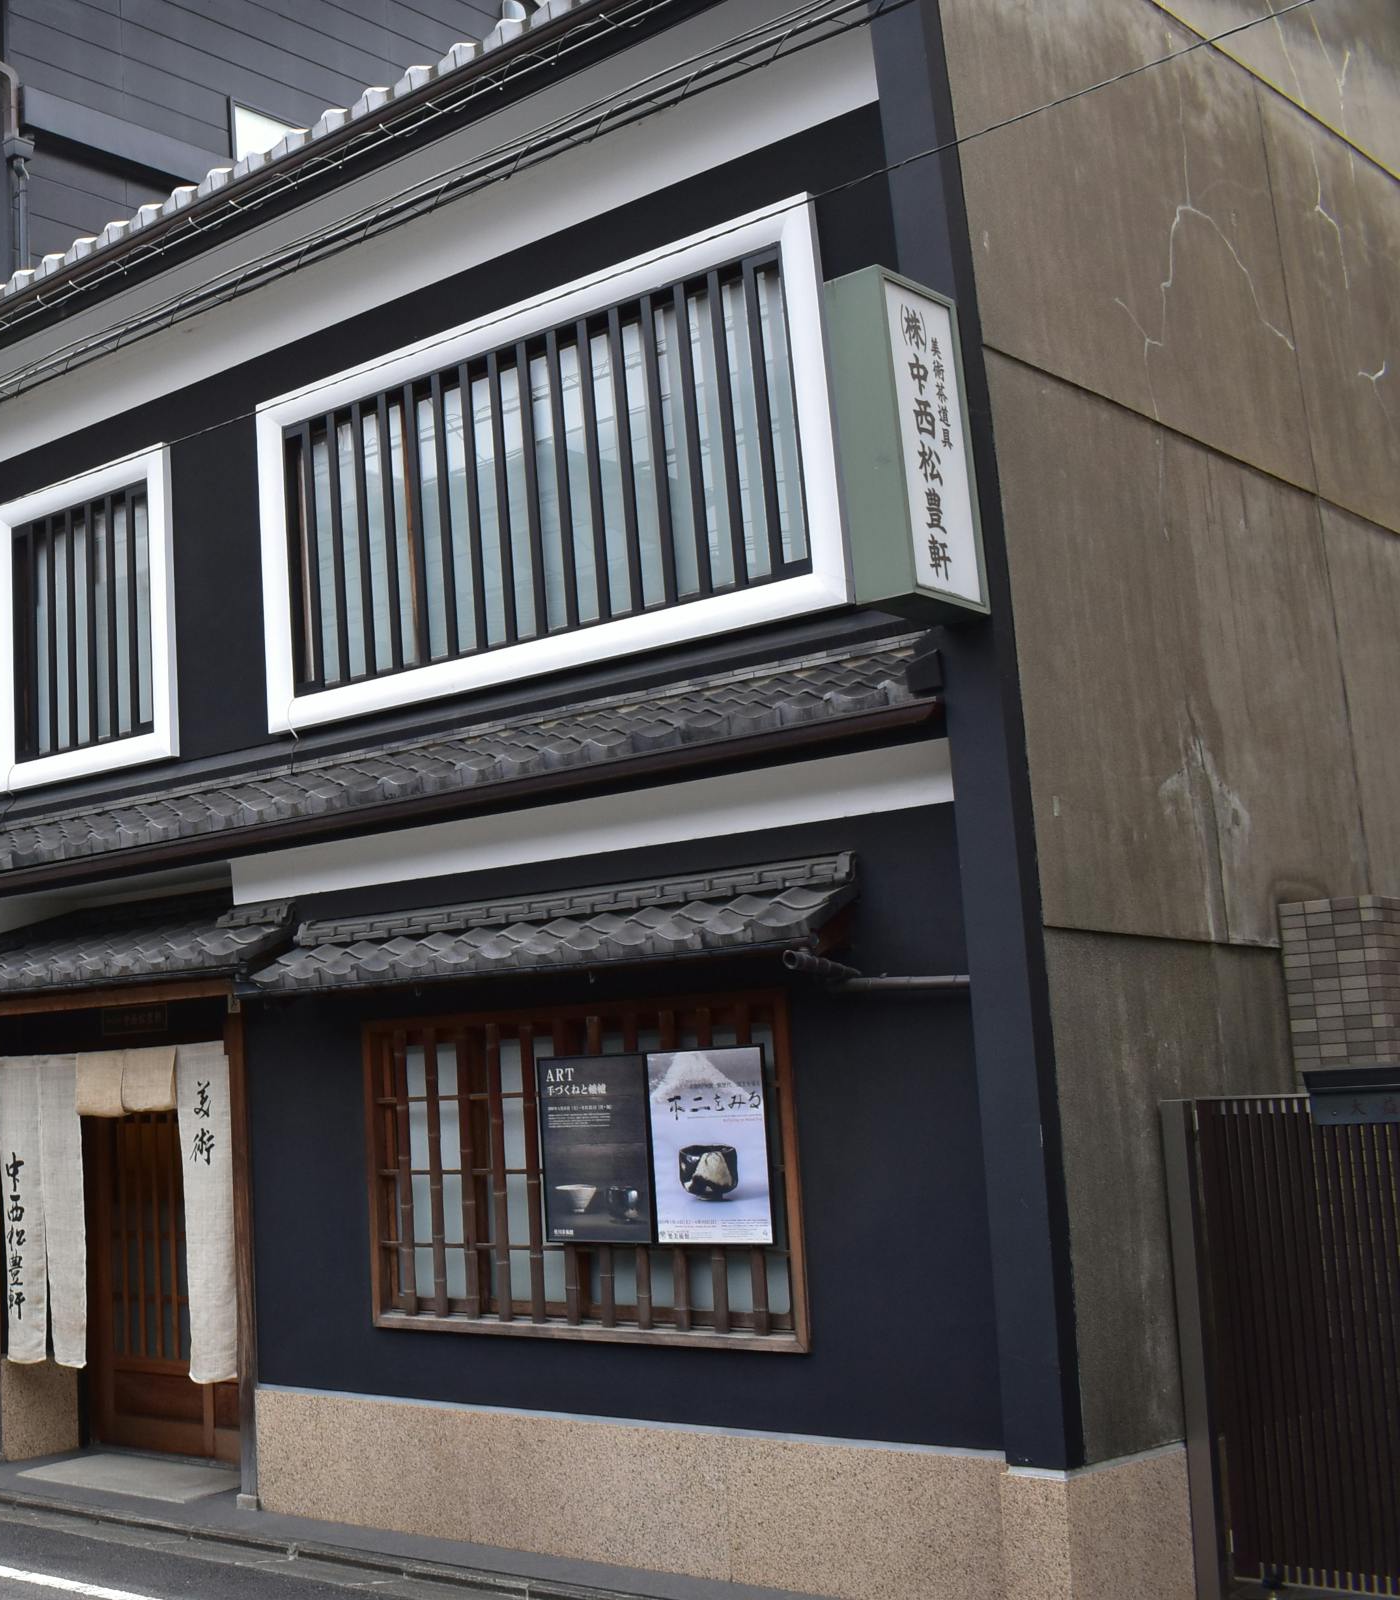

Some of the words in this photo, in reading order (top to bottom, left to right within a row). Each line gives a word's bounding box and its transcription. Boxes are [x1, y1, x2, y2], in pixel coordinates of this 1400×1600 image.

[931, 337, 953, 450] 美術茶道具
[189, 1081, 215, 1166] 美術
[546, 1067, 575, 1082] ART
[5, 1152, 27, 1320] 中西松豊軒
